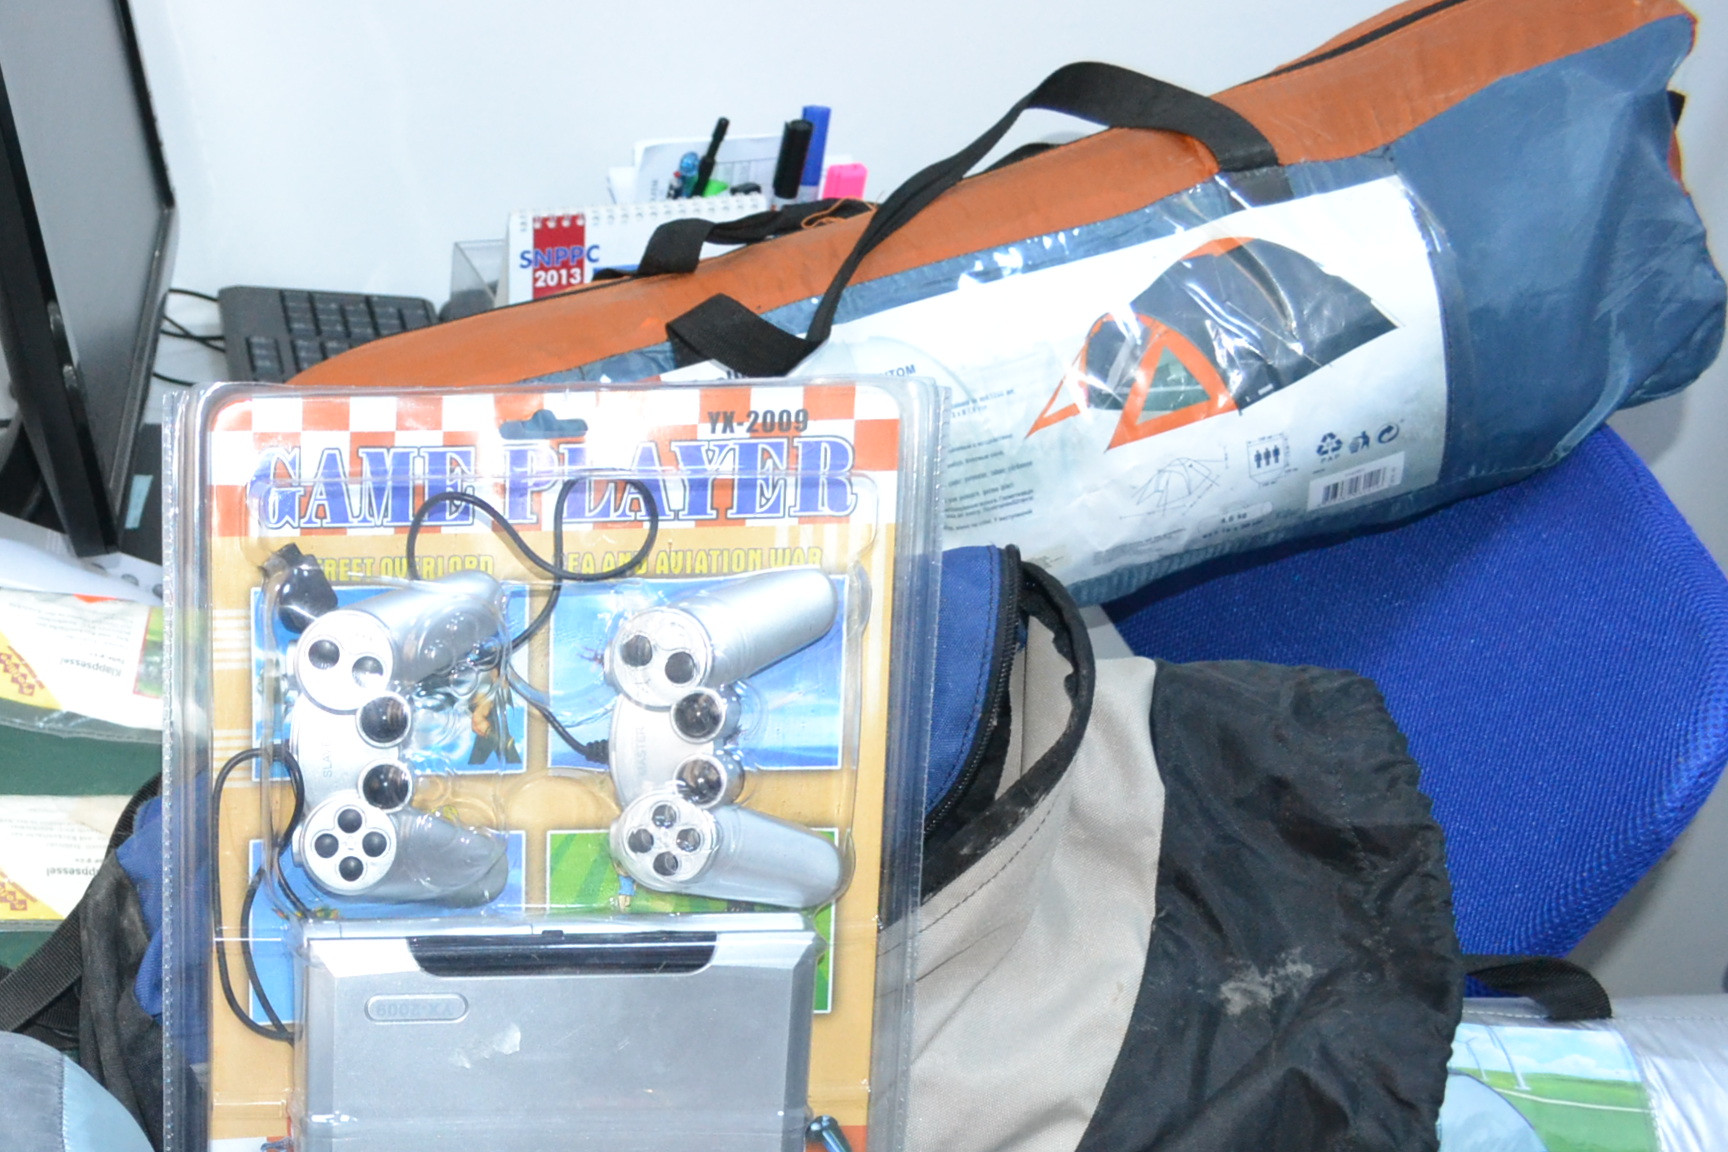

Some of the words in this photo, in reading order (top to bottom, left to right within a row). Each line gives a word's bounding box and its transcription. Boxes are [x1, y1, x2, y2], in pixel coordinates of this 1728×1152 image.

[519, 244, 600, 269] SNPPC
[534, 267, 582, 288] 2013
[707, 408, 810, 434] YX-2009
[247, 445, 476, 529] GAME
[502, 434, 859, 525] PLAYER
[568, 552, 597, 576] EA
[656, 548, 764, 575] AVIATION
[770, 546, 823, 568] WAR
